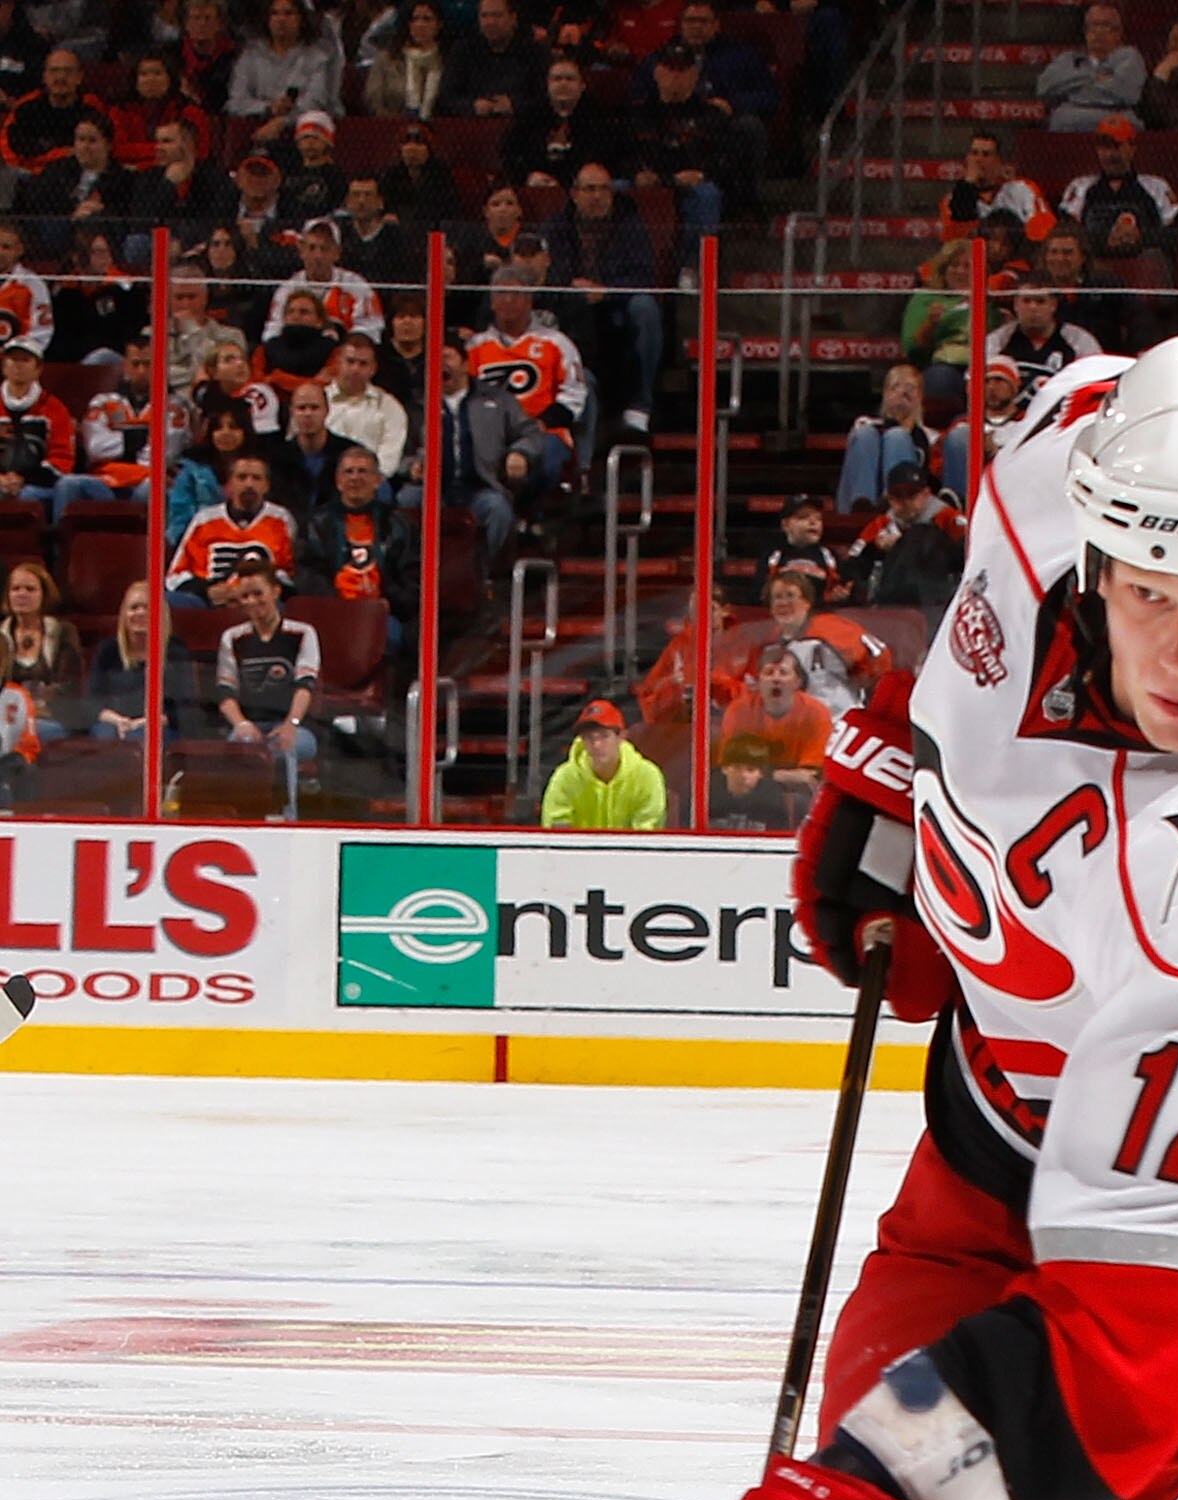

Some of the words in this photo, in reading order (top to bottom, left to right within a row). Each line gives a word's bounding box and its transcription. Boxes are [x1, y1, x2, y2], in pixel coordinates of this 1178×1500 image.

[825, 720, 914, 798] UE
[1005, 783, 1110, 910] C
[0, 837, 258, 957] LL'S
[0, 968, 256, 1003] OODS
